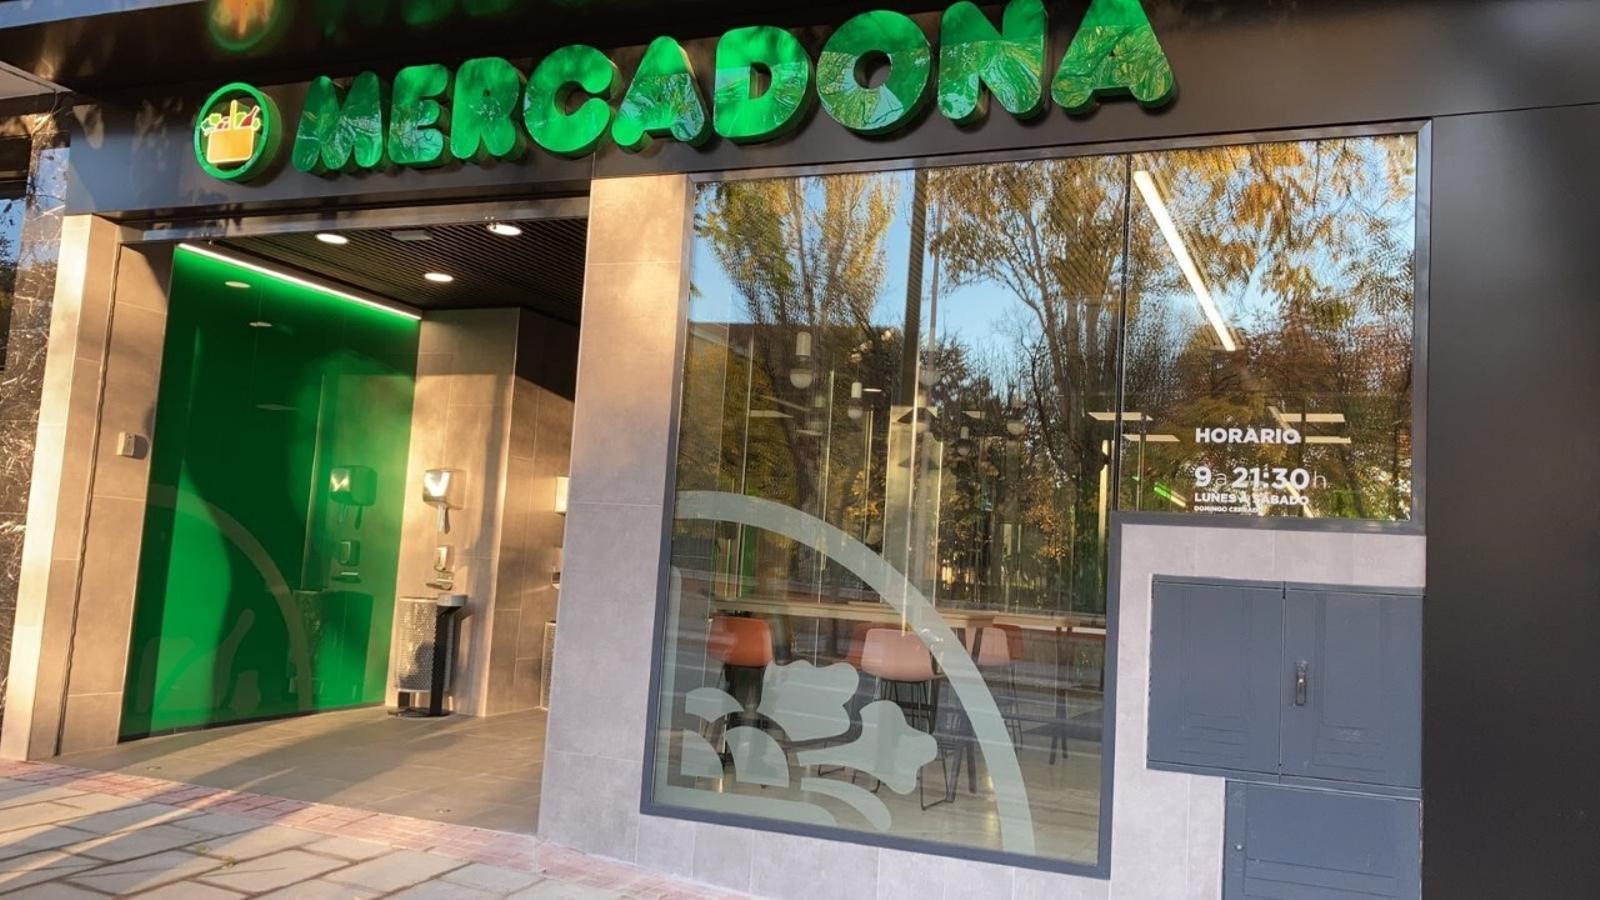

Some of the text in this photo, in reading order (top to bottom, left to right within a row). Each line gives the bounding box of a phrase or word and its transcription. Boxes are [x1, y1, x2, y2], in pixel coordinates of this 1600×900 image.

[292, 0, 1177, 173] MERCADONA
[1195, 427, 1301, 444] HORARIO
[1194, 466, 1212, 487] 9
[1215, 473, 1227, 486] a
[1313, 470, 1327, 489] h
[1194, 492, 1236, 503] LUNES
